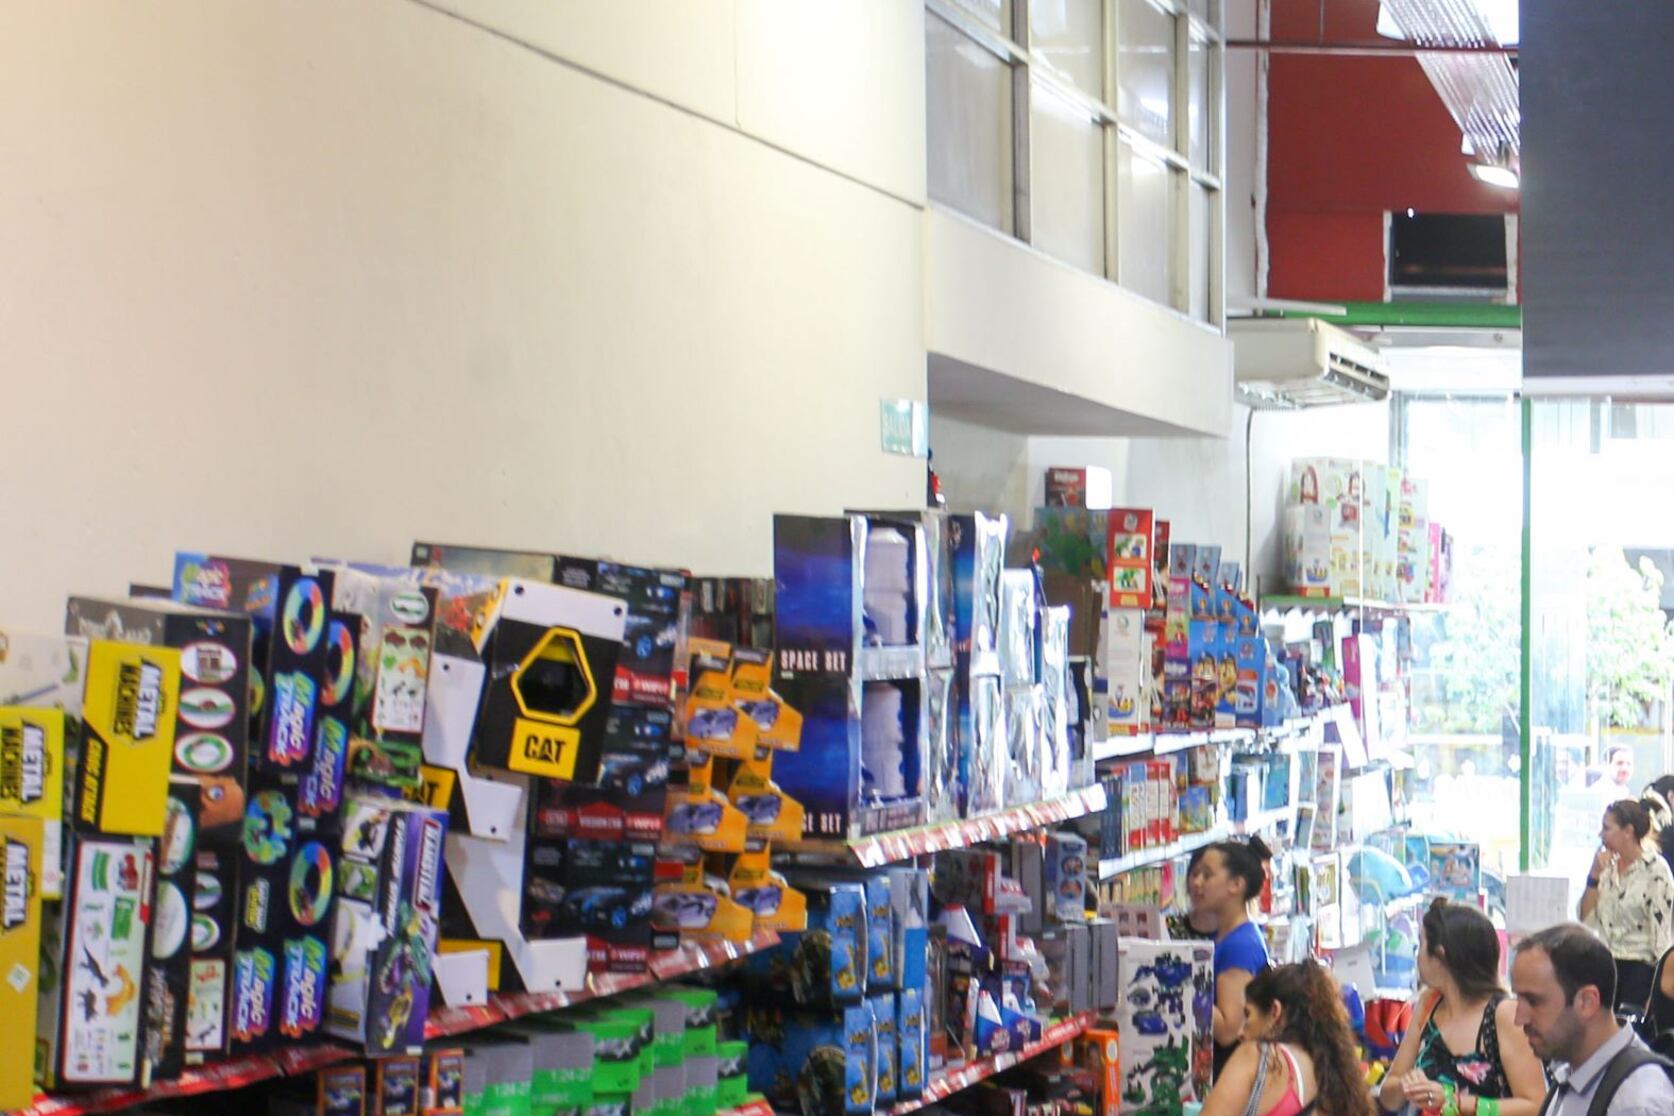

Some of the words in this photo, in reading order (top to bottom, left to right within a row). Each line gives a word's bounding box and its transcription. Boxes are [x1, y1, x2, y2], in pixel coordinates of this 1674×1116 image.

[134, 658, 162, 740] METAL
[780, 650, 819, 673] SPACE
[824, 650, 848, 673] SET
[274, 675, 296, 761] TRACK
[286, 671, 313, 762] Magic
[524, 734, 566, 765] CAT
[20, 721, 45, 803] METAL
[318, 716, 347, 812] Magic
[5, 841, 29, 929] METAL
[235, 950, 255, 1034] TRACK
[250, 946, 274, 1035] Magic
[280, 938, 304, 1038] TRACK
[299, 935, 328, 1032] Magic
